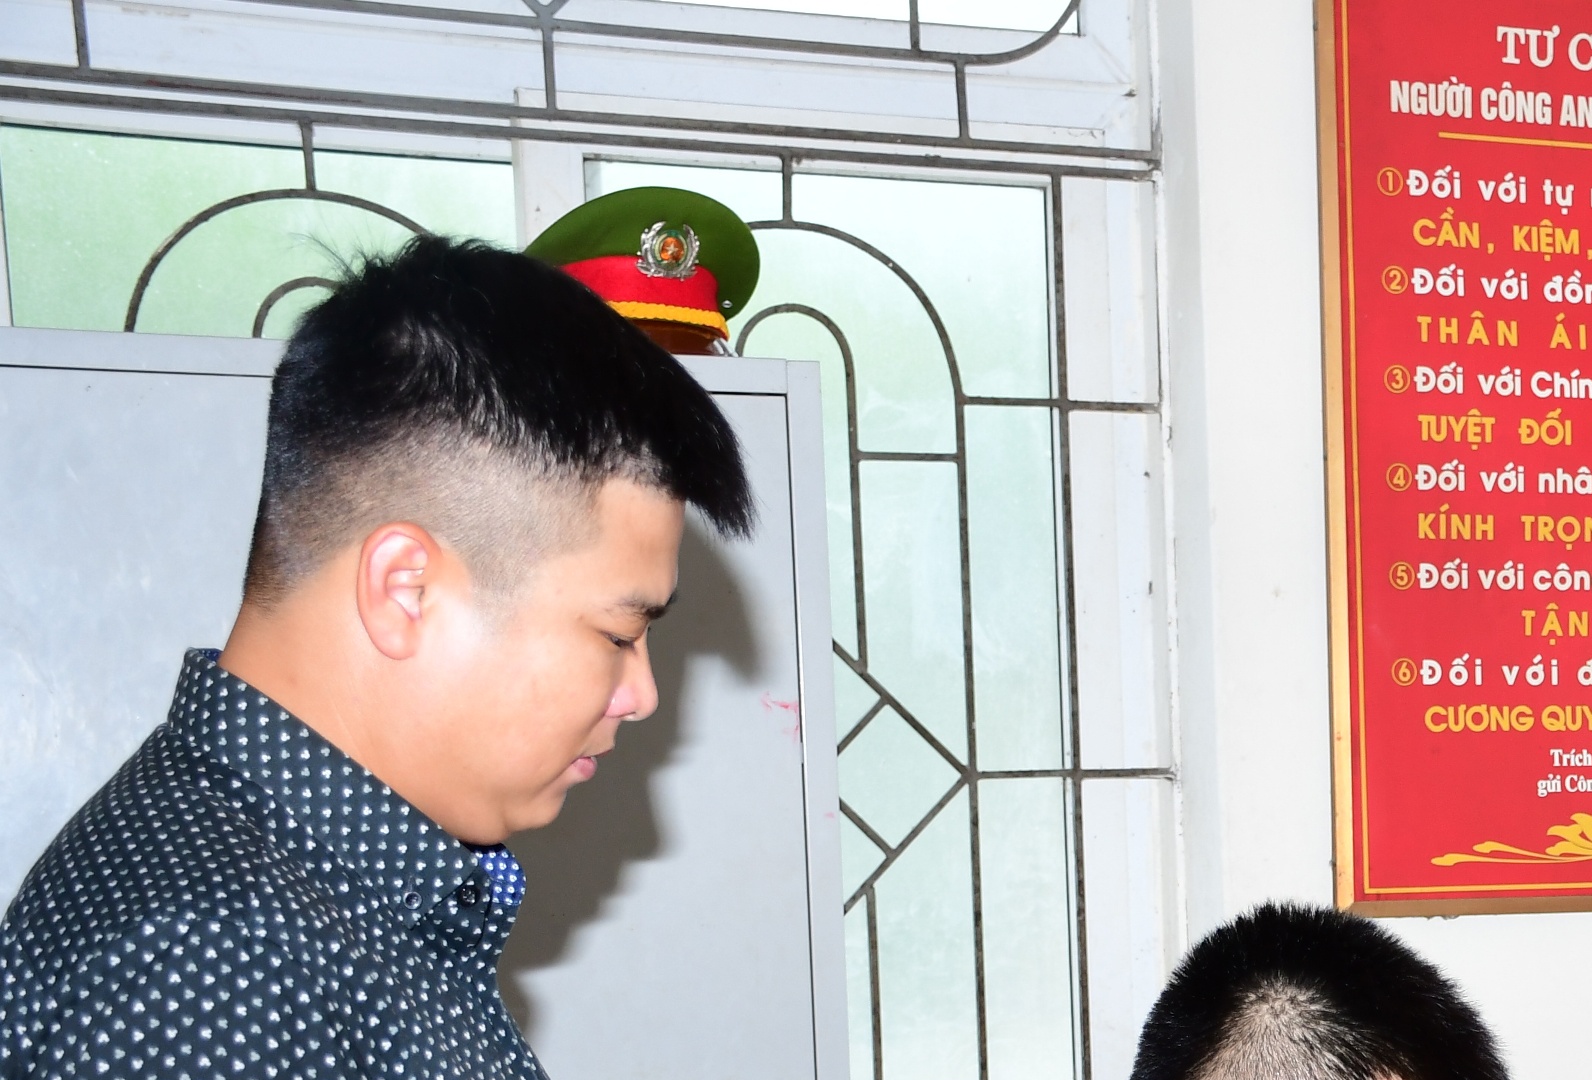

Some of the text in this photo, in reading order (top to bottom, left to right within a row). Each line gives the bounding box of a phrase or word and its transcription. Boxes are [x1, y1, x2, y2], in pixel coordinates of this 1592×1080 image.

[1496, 25, 1561, 68] TƯ
[1390, 76, 1473, 119] NGƯỜI
[1480, 81, 1552, 125] CÔNG
[1406, 165, 1461, 199] Đối
[1477, 172, 1527, 204] với
[1542, 179, 1575, 215] tự
[1410, 263, 1465, 297] Đối
[1480, 268, 1528, 301] với
[1417, 311, 1518, 346] THÂN
[1551, 313, 1587, 350] ÁI
[1413, 361, 1464, 394] Đối
[1477, 365, 1522, 396] với
[1418, 409, 1495, 449] TUYỆT
[1519, 408, 1572, 445] ĐỐI
[1414, 459, 1465, 492] Đối
[1479, 462, 1525, 493] với
[1418, 504, 1494, 540] KÍNH
[1416, 558, 1469, 590] Đối
[1477, 560, 1524, 591] với
[1522, 603, 1588, 645] TẬN
[1419, 653, 1482, 686] Đối
[1501, 654, 1559, 686] với
[1425, 704, 1534, 732] CƯƠNG
[1549, 748, 1592, 767] Trích
[1537, 773, 1562, 798] gửi
